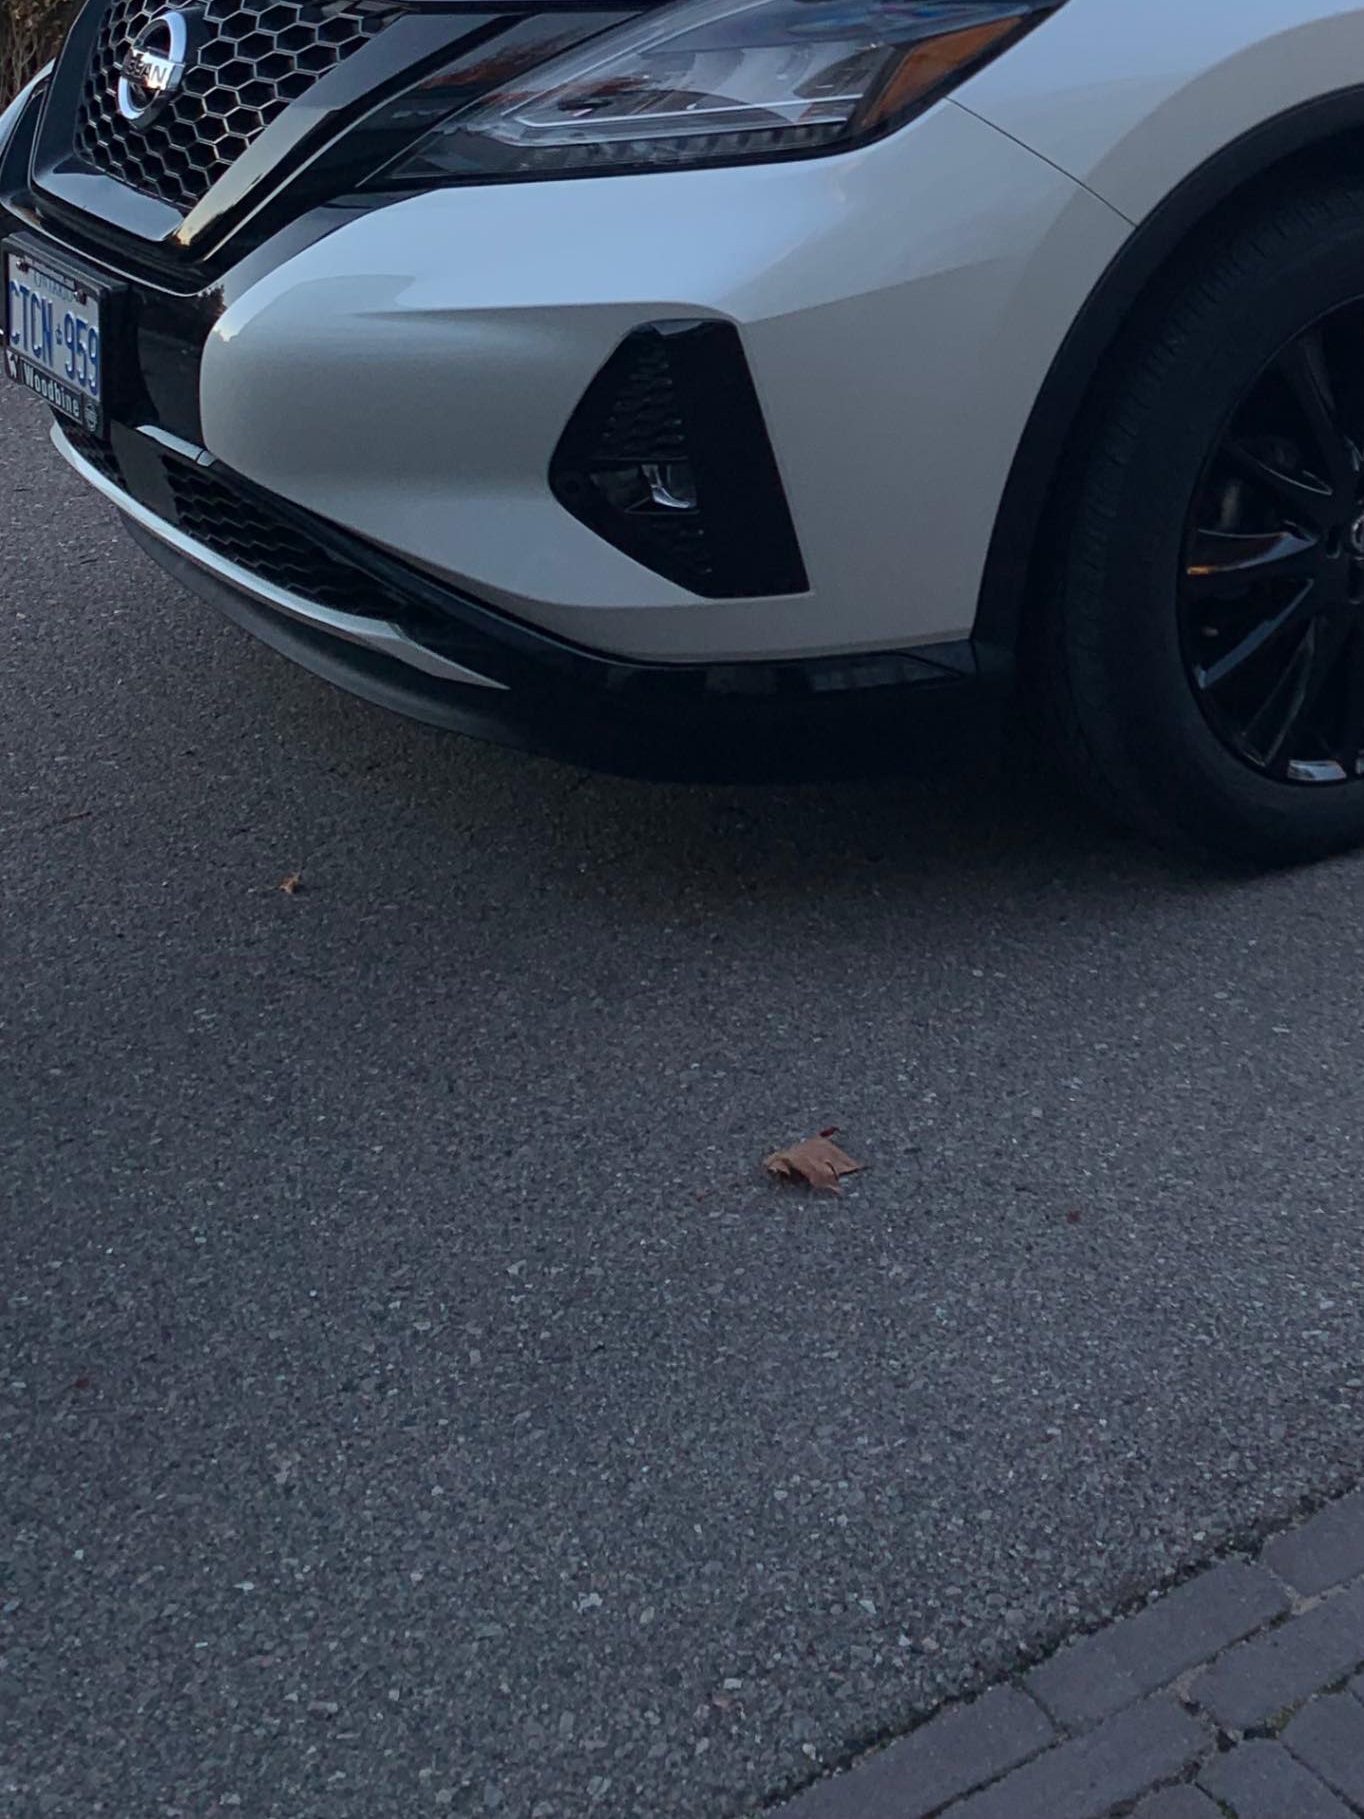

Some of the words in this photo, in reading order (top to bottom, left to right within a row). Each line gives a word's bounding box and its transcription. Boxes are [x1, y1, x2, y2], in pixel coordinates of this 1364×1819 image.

[9, 279, 54, 368] CTCN
[63, 311, 100, 396] 959
[23, 362, 80, 418] Woodbine
